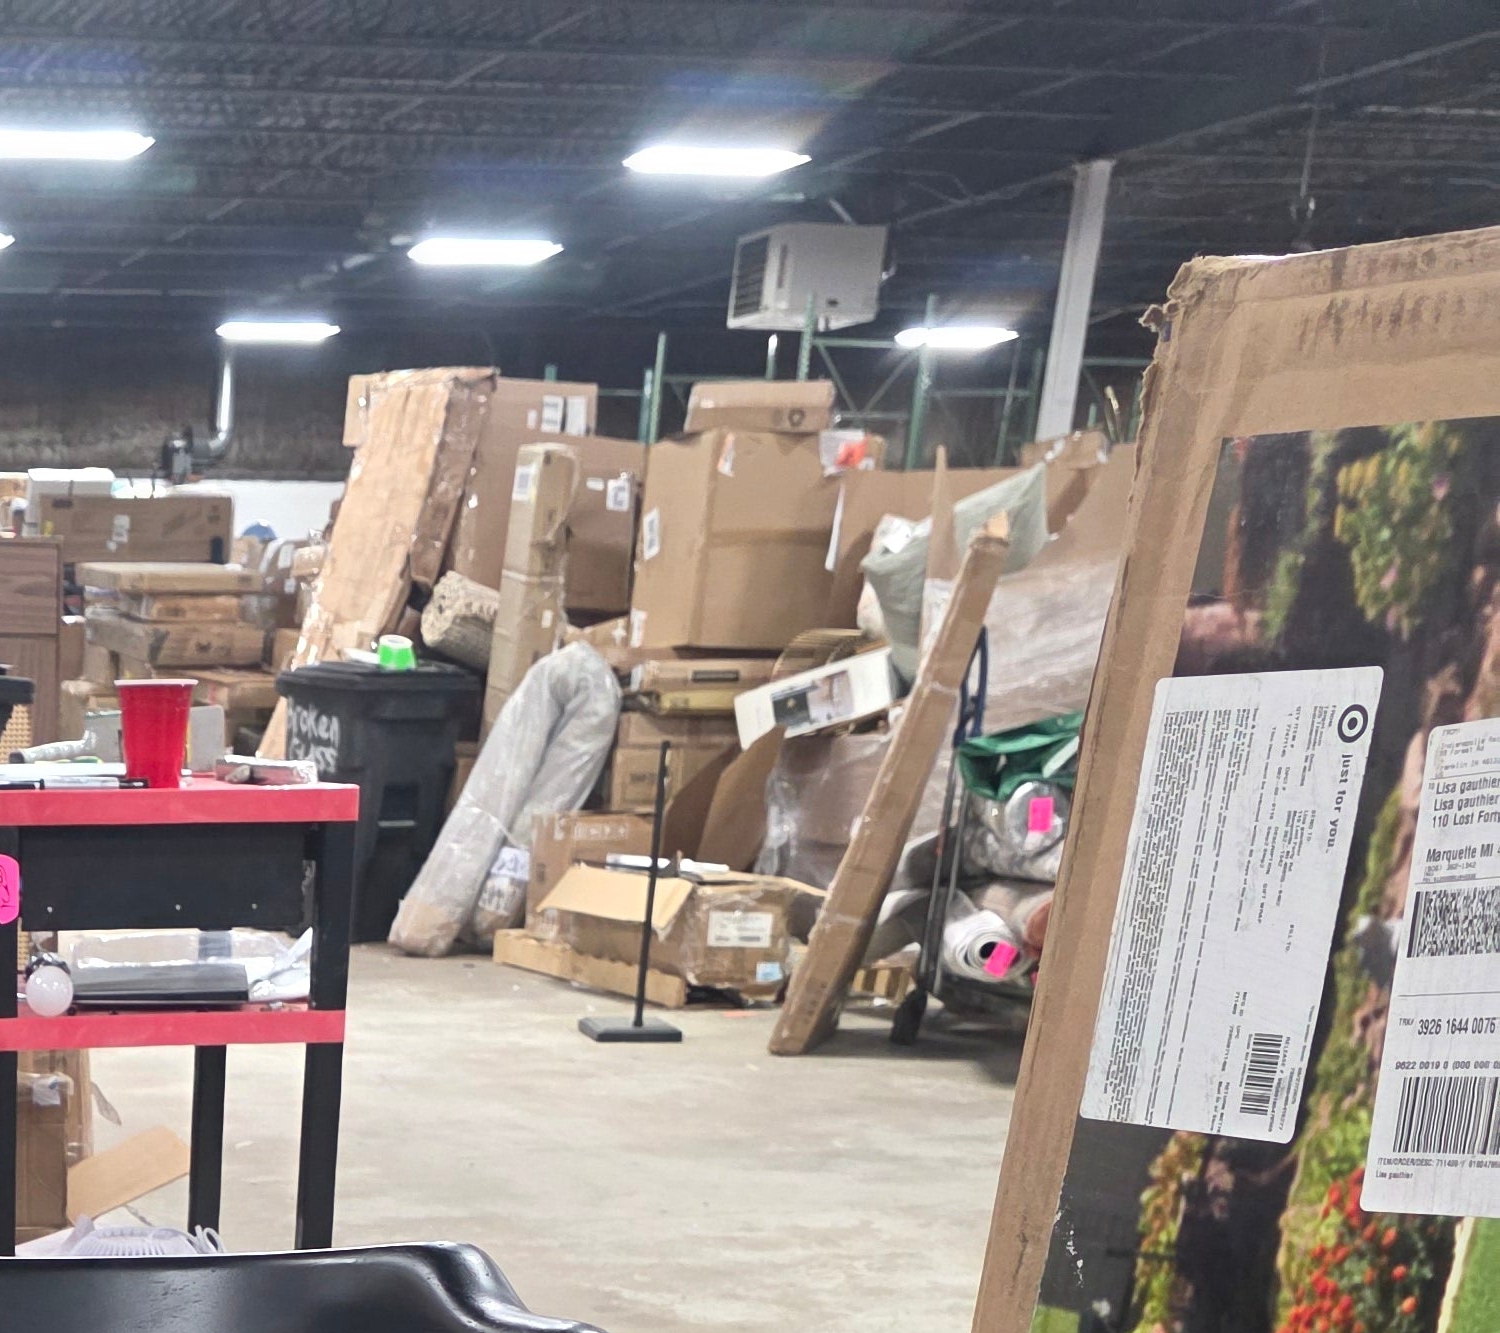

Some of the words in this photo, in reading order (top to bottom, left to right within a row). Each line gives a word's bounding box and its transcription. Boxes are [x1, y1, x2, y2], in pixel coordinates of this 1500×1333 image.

[1335, 753, 1353, 784] just
[1436, 782, 1456, 795] Lisa
[1332, 789, 1347, 812] for
[1434, 799, 1453, 811] Lisa
[1458, 794, 1499, 811] gauthier
[1432, 814, 1449, 828] 110
[1453, 812, 1474, 826] Lost
[1426, 847, 1477, 863] Marquette
[1480, 843, 1493, 857] MI
[1418, 1019, 1442, 1035] 3926
[1446, 1018, 1469, 1034] 1644
[1472, 1017, 1496, 1034] 0076
